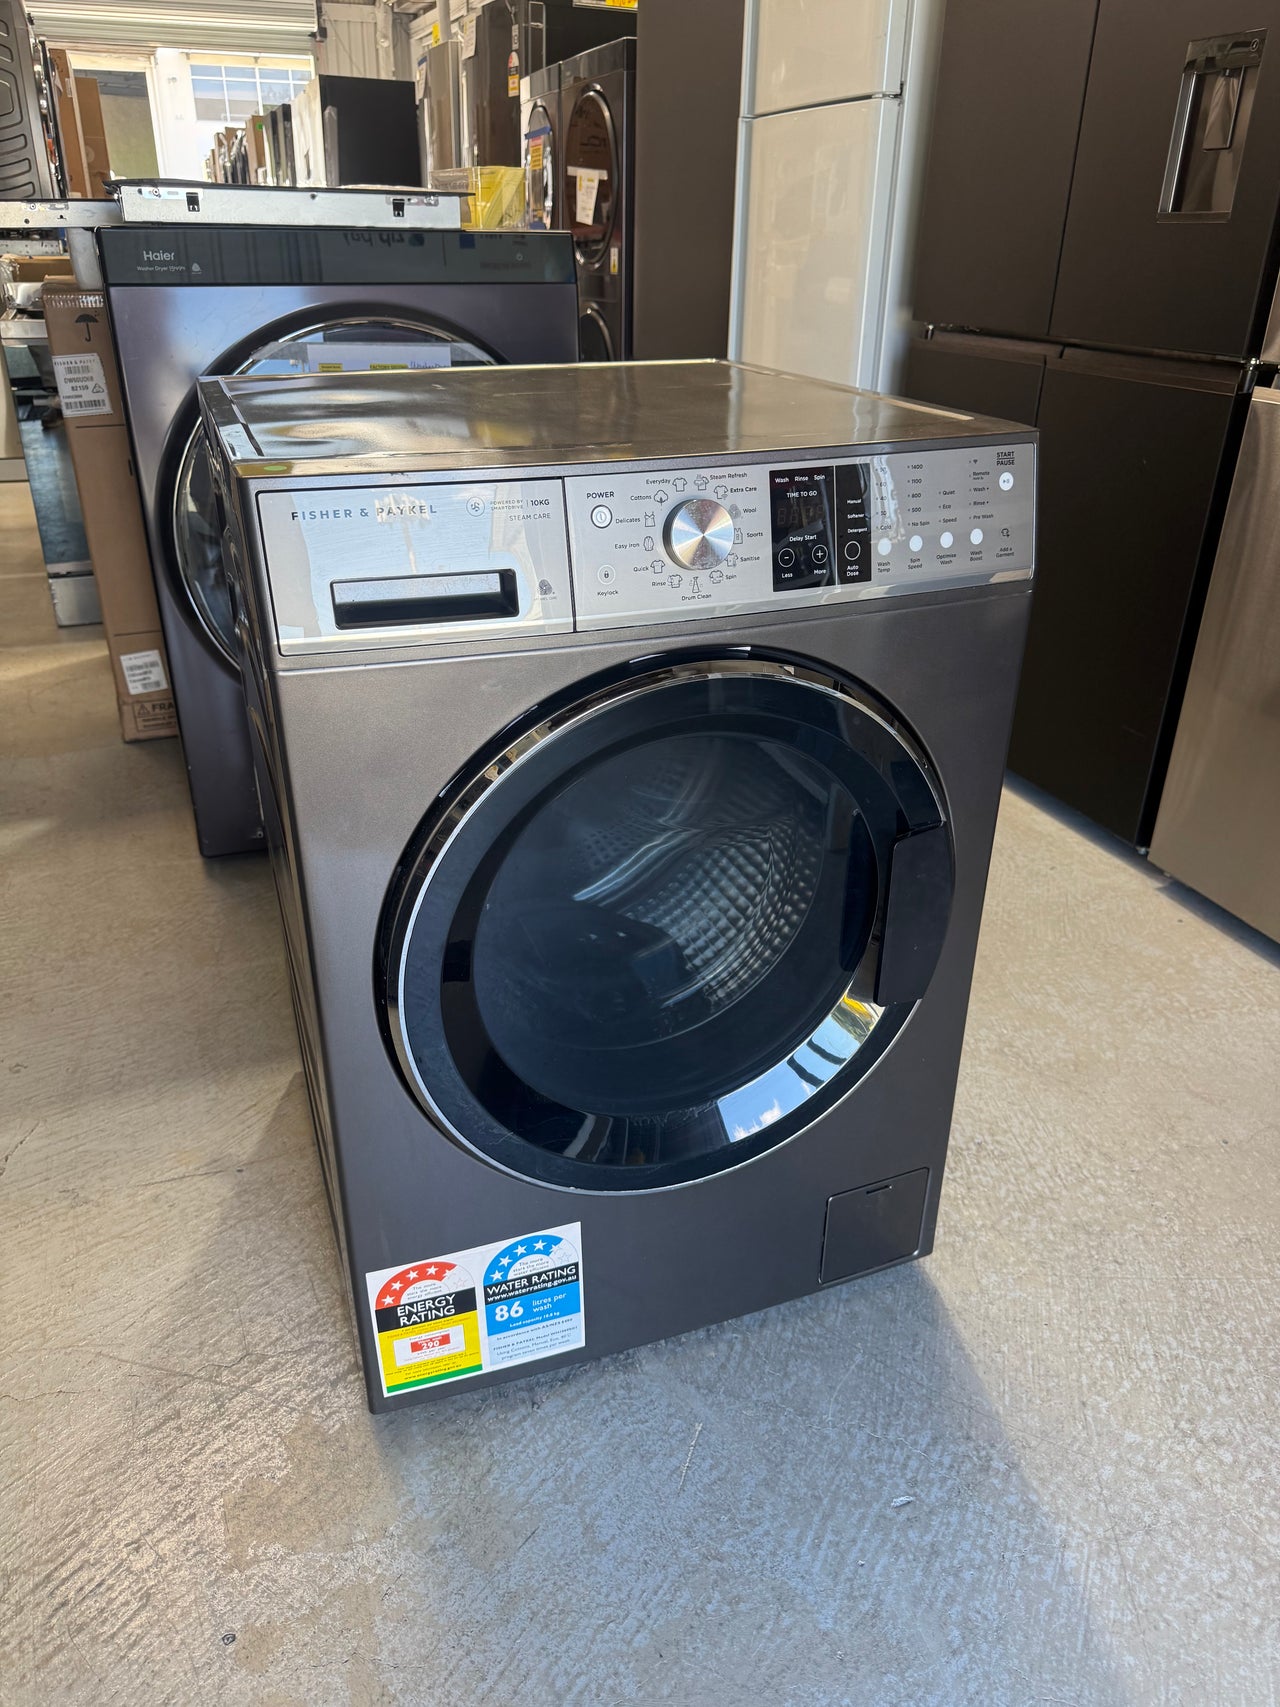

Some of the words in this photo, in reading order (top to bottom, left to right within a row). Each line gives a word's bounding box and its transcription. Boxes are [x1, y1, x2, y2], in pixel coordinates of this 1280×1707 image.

[143, 250, 175, 261] Haier
[587, 491, 615, 499] POWER
[531, 499, 550, 507] 10KG
[292, 509, 352, 521] FISHER
[360, 508, 369, 518] &
[376, 505, 437, 516] PAYKEL
[486, 1277, 529, 1296] WATER
[532, 1265, 576, 1284] RATING
[487, 1274, 577, 1302] www.waterrating.gov.au
[397, 1294, 456, 1317] ENERGY
[532, 1296, 552, 1306] litres
[554, 1293, 567, 1303] per
[495, 1300, 524, 1323] 86
[533, 1303, 552, 1313] wash
[400, 1305, 455, 1327] RATING
[510, 1320, 522, 1328] Load
[523, 1316, 542, 1325] capacity
[422, 1340, 440, 1350] 290
